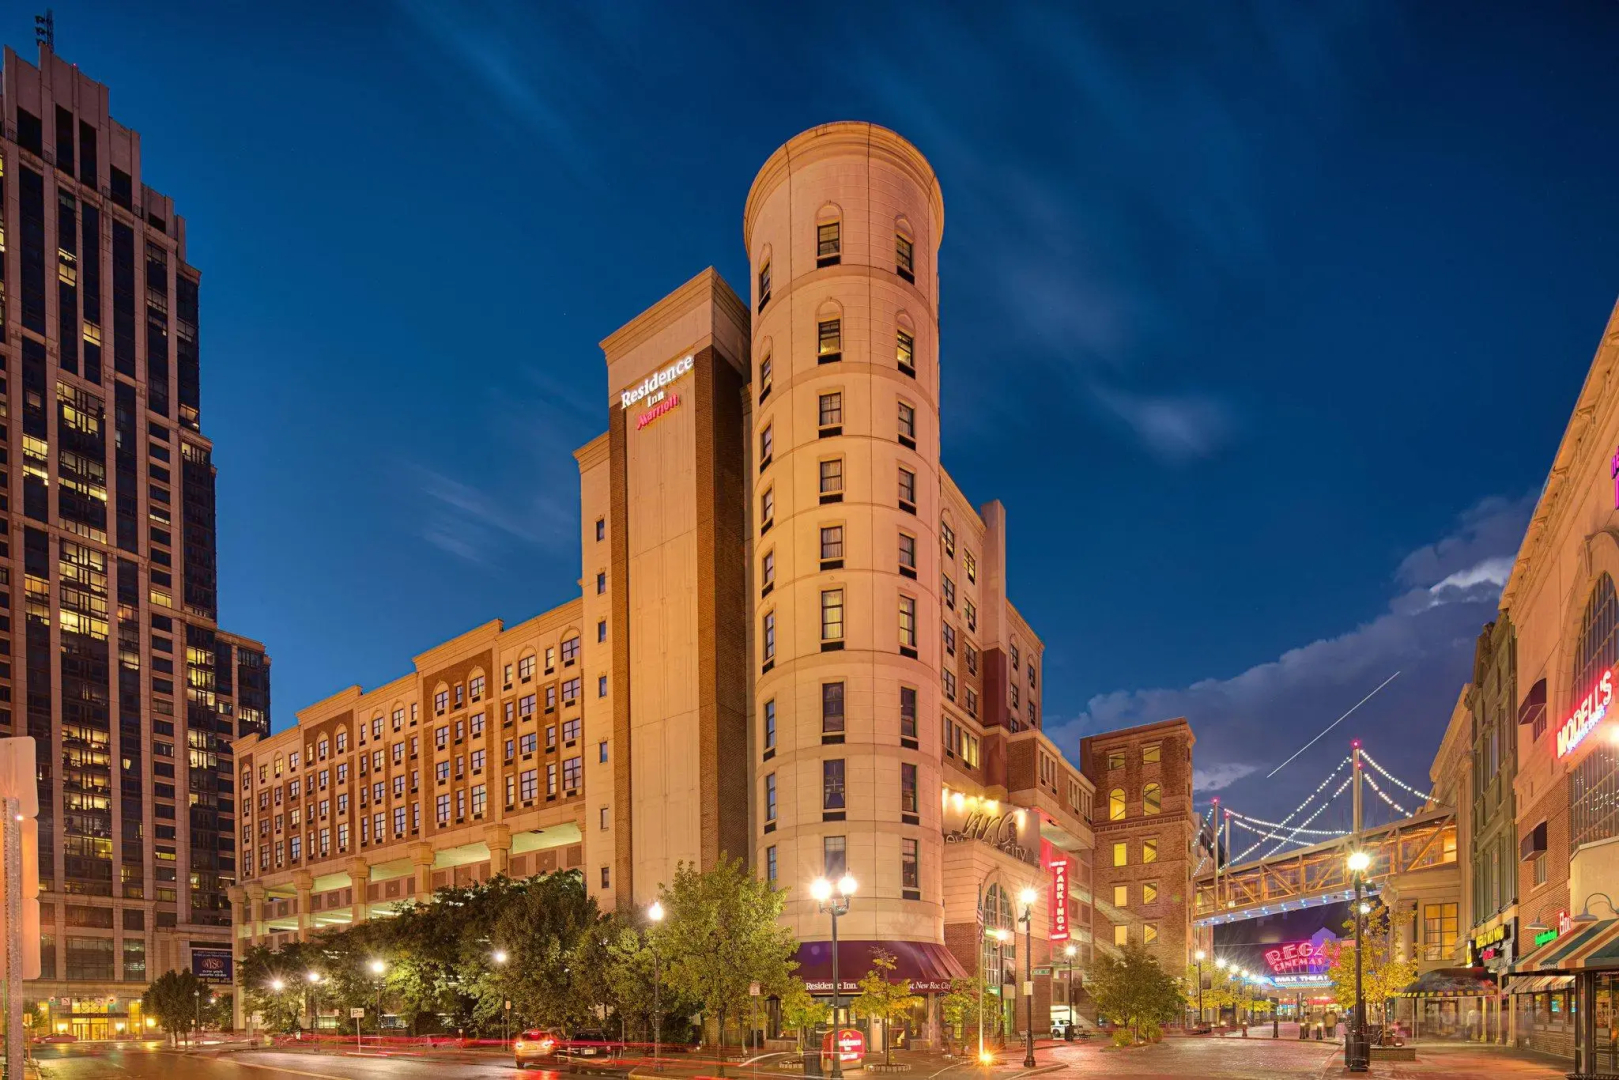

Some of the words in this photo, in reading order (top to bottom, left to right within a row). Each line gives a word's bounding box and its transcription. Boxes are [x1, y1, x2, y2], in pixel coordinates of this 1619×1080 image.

[621, 356, 693, 409] Residence
[637, 394, 678, 430] Marriott
[647, 391, 664, 407] Inn
[1557, 670, 1612, 758] MODELL'S
[1056, 866, 1065, 924] PARKING
[1274, 957, 1324, 972] CINEMAS
[806, 982, 842, 990] Residene
[941, 982, 952, 990] City
[839, 1039, 862, 1047] esidence
